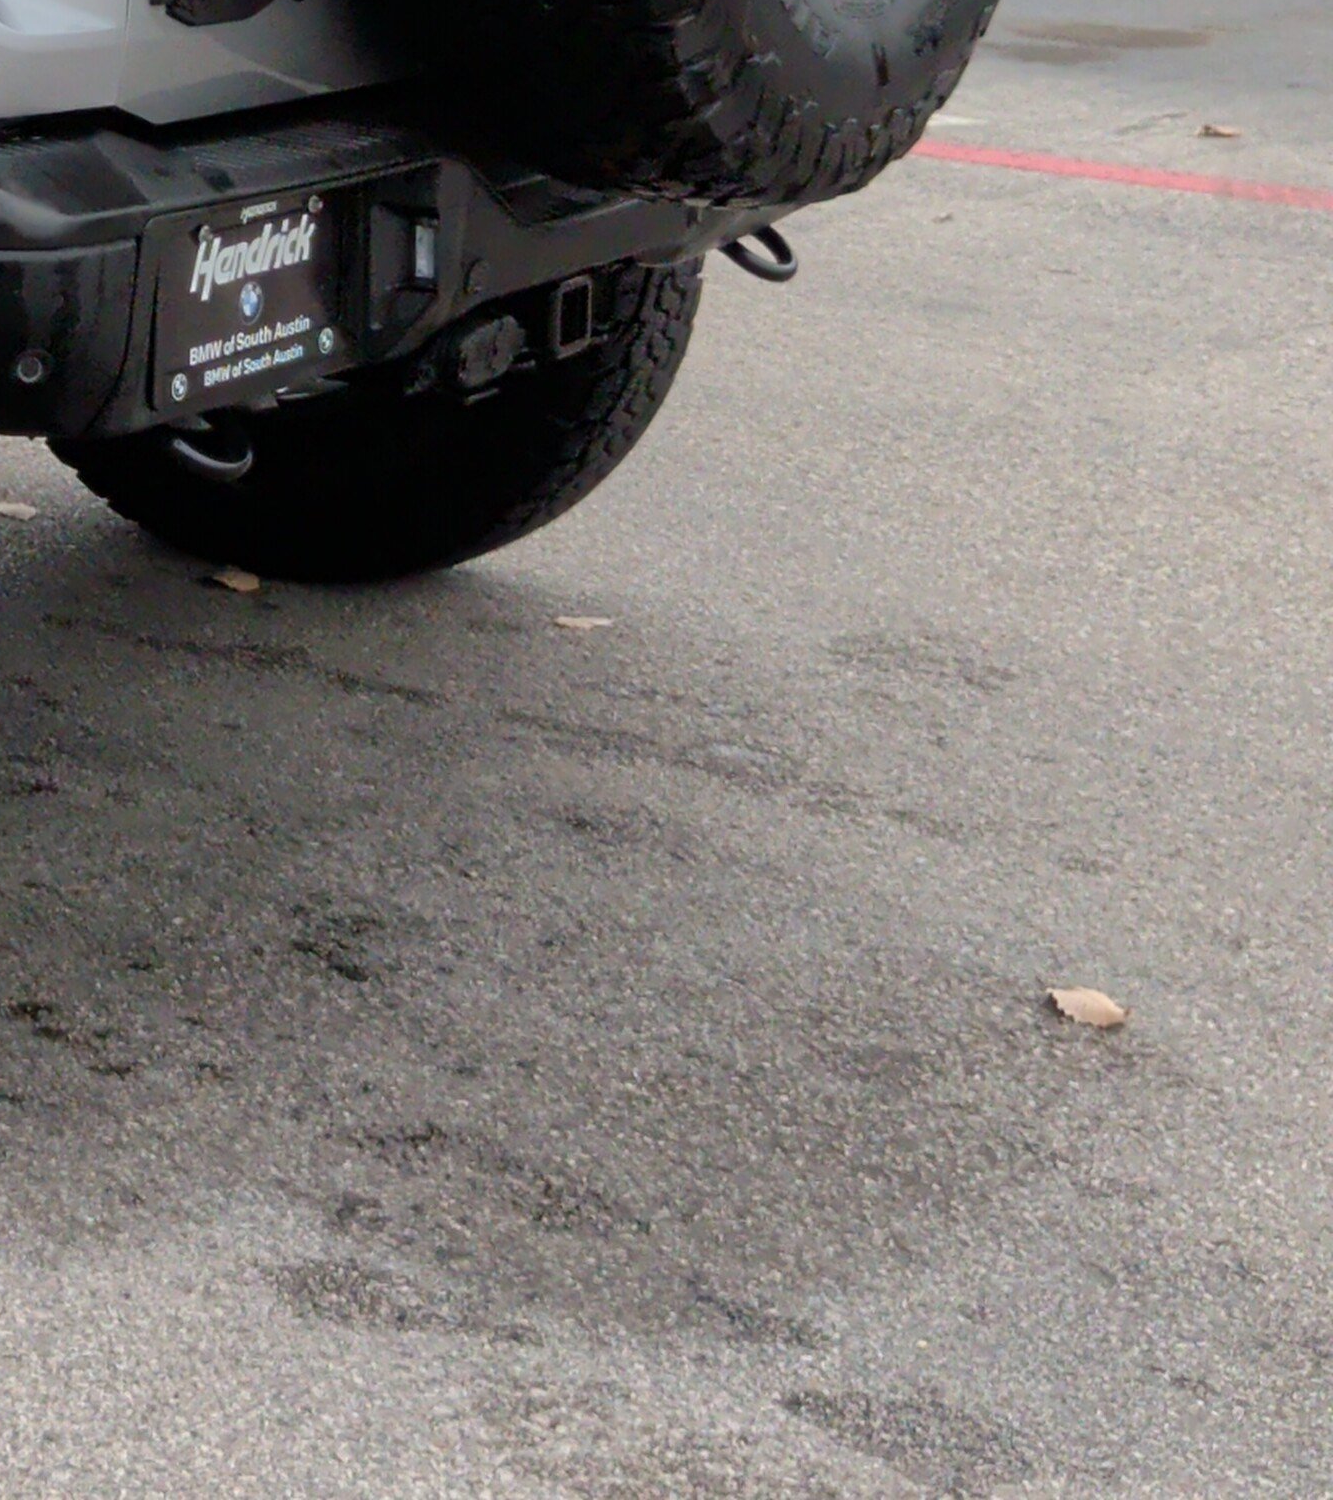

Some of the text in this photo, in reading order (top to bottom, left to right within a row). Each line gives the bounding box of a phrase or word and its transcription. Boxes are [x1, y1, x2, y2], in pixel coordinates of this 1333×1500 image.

[189, 213, 317, 302] Hendrick
[189, 314, 311, 367] BMW of South Austin
[203, 342, 304, 387] BMW of South Austin
